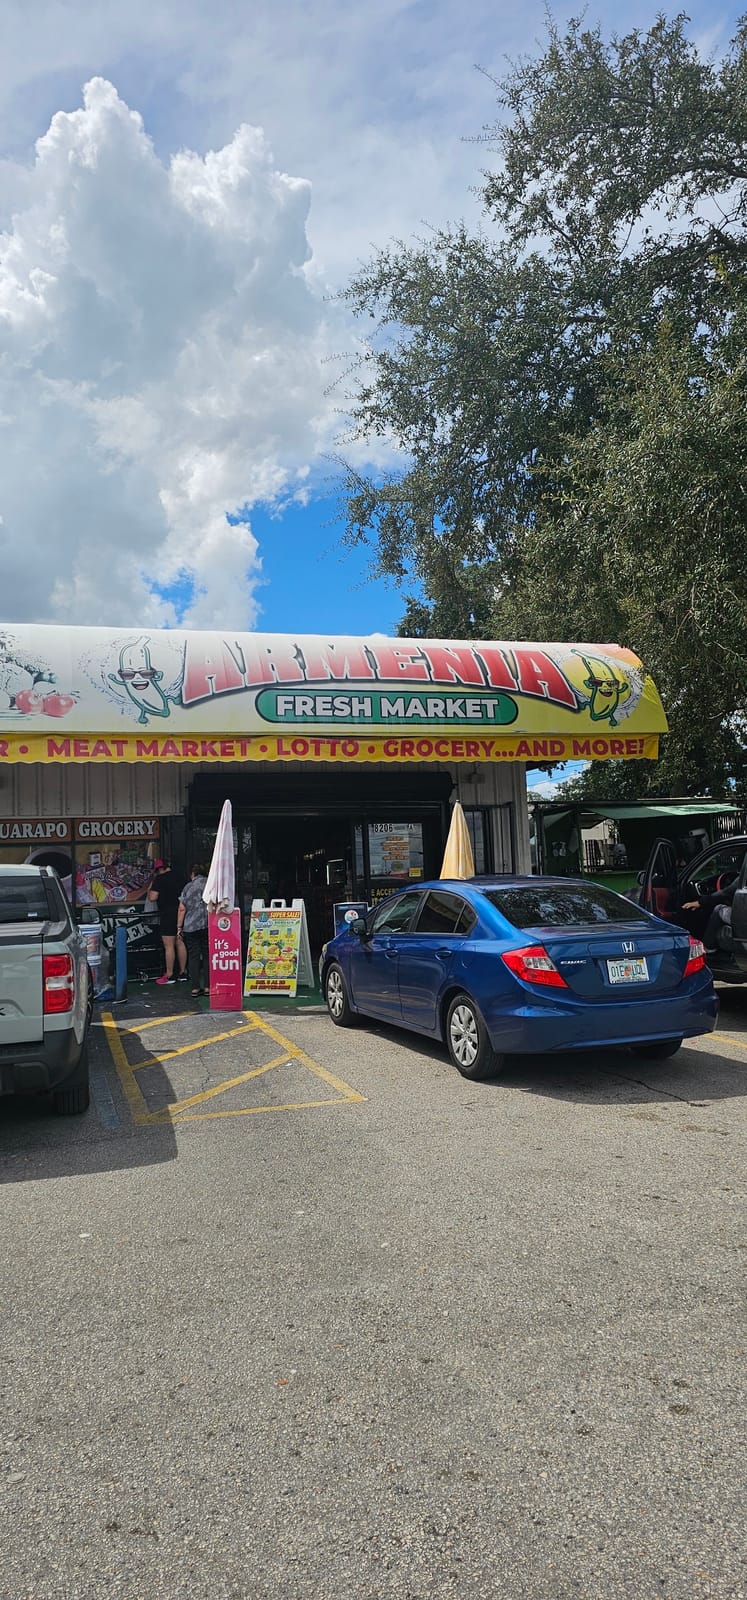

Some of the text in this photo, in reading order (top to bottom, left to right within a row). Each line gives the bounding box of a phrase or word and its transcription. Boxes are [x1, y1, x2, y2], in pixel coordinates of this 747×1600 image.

[180, 639, 579, 708] ARMENIA
[276, 695, 499, 720] FRESH MARKET
[47, 739, 128, 758] MEAT
[136, 738, 252, 757] MARKET
[276, 738, 360, 757] LOTTO
[572, 738, 645, 757] MORE!
[78, 819, 156, 837] GROCERY
[373, 823, 393, 833] 8206
[104, 922, 153, 948] BER
[214, 939, 229, 949] it's
[212, 954, 239, 970] fun
[219, 949, 239, 958] good
